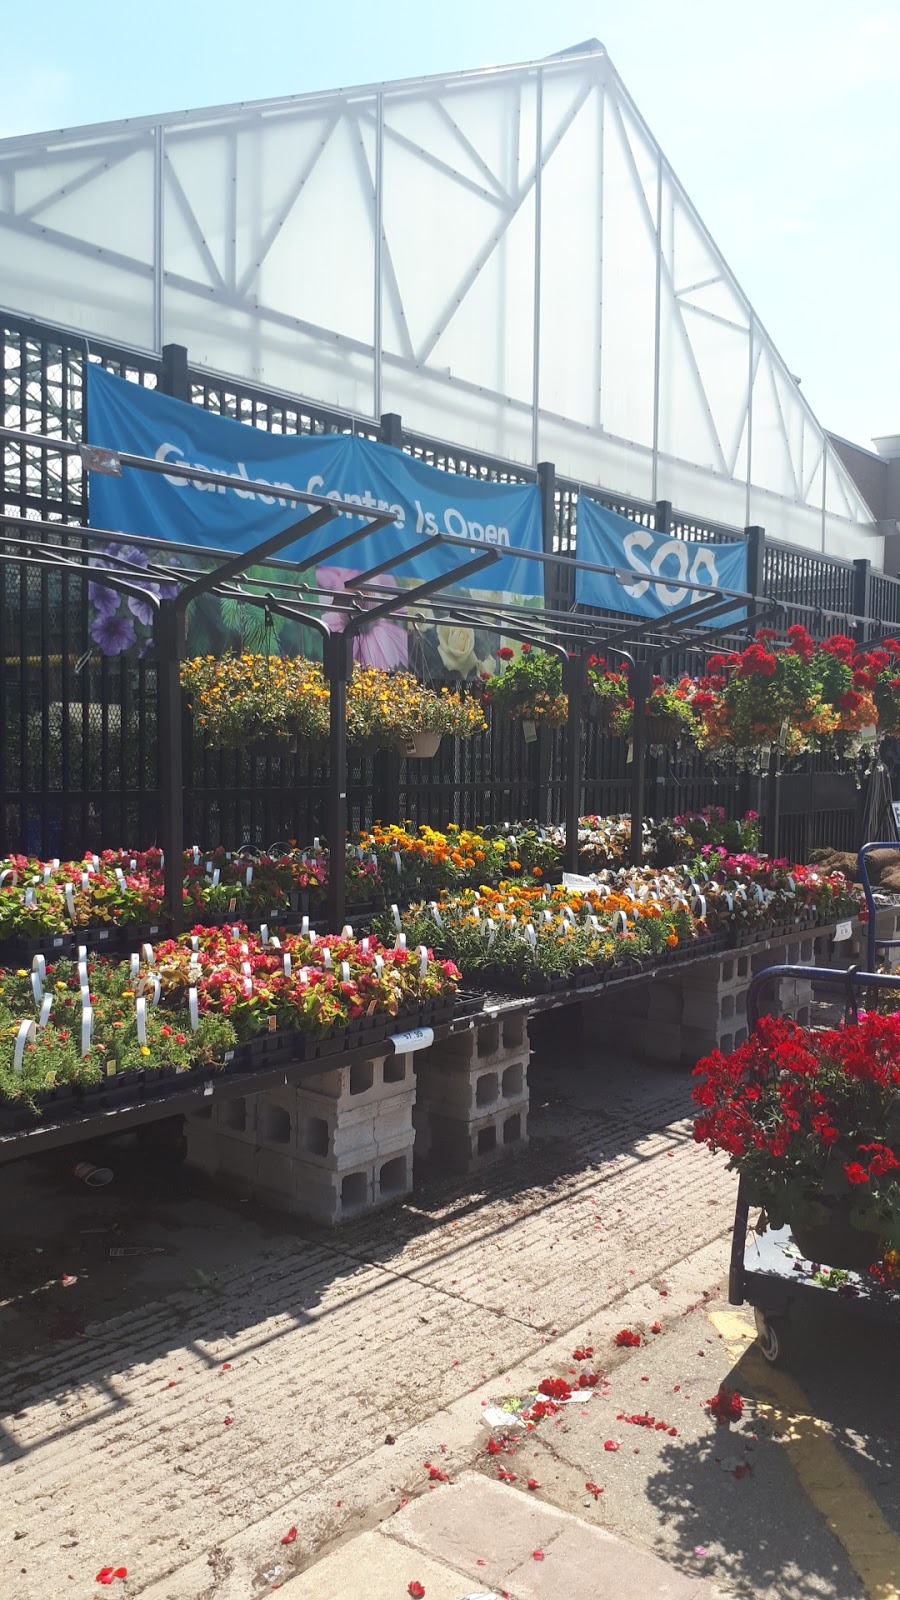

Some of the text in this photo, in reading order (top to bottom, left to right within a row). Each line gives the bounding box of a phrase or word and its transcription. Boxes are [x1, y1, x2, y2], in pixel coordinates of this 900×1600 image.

[415, 500, 439, 536] Is
[444, 508, 511, 554] Open
[622, 530, 719, 607] SOD
